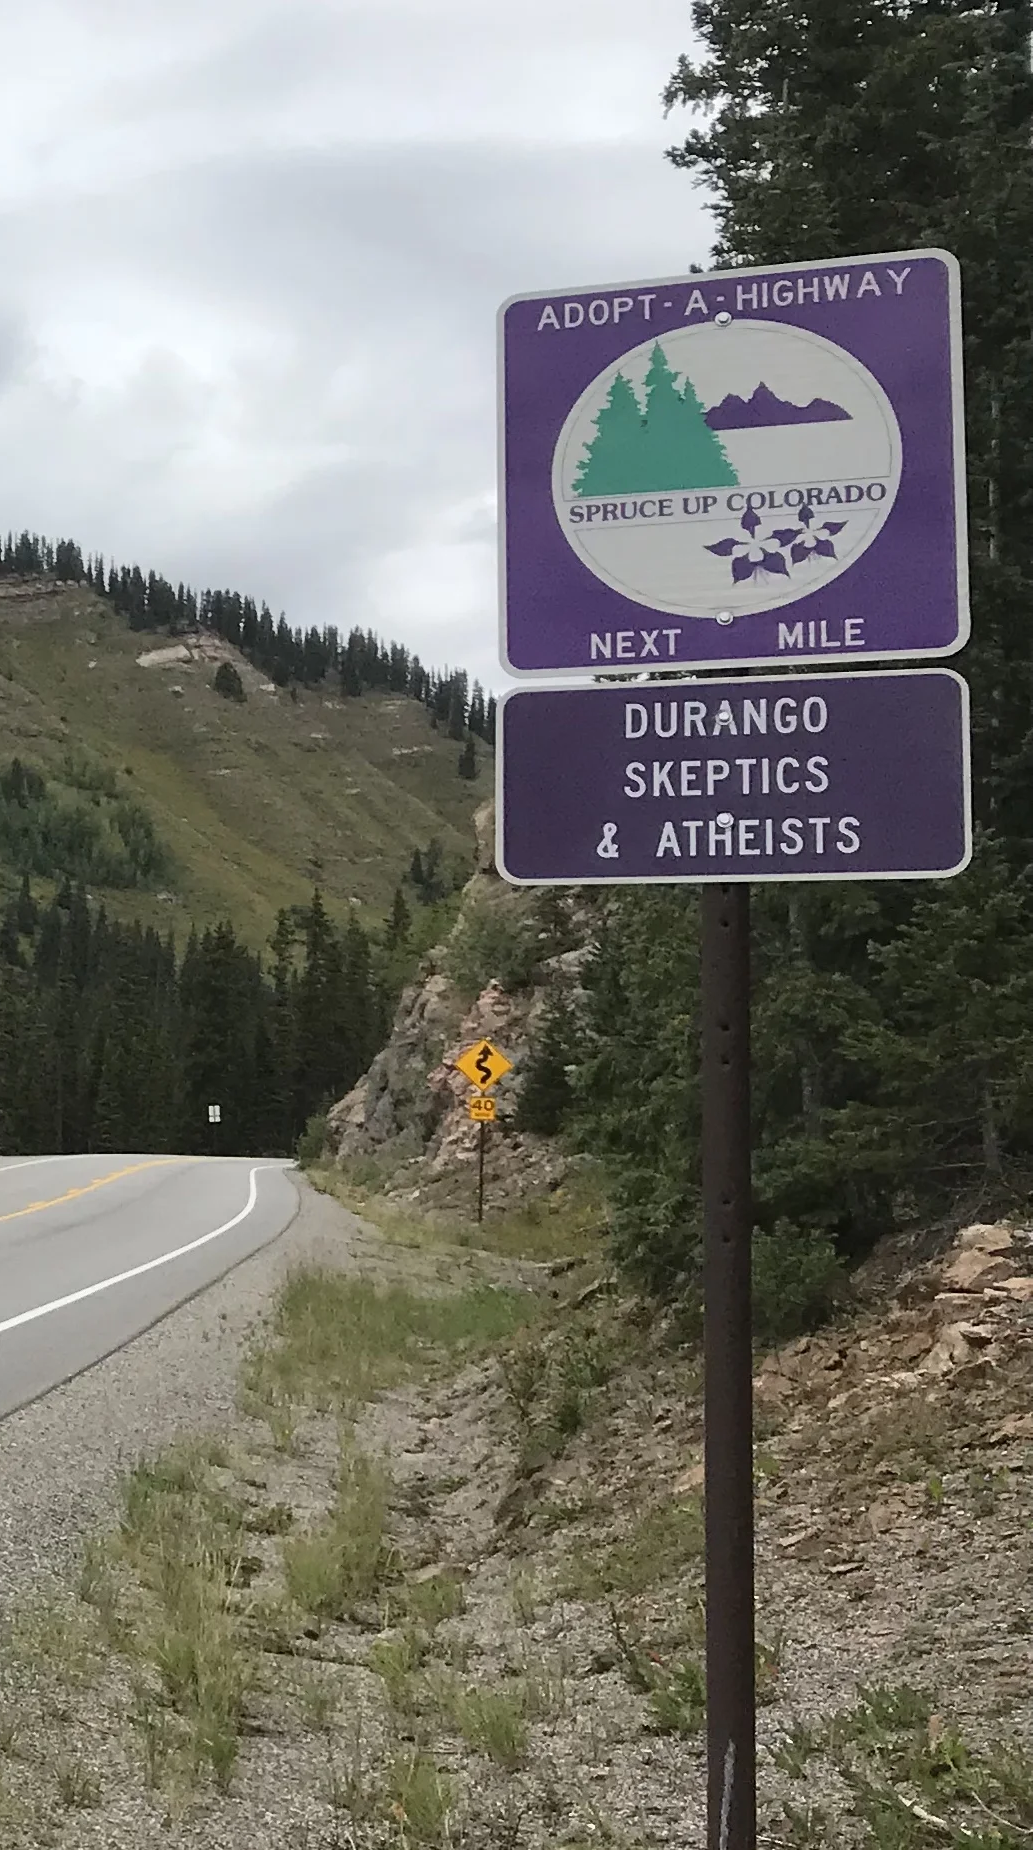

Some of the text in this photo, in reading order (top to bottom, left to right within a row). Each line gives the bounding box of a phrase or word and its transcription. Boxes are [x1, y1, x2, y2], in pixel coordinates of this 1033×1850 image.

[569, 482, 887, 524] SPRUCE UP COLORADO
[590, 618, 865, 660] NEXT MILE
[624, 696, 828, 739] DURANGO
[623, 755, 830, 798] SKEPTICS
[596, 815, 861, 859] & ATHEISTS
[471, 1100, 495, 1111] 40
